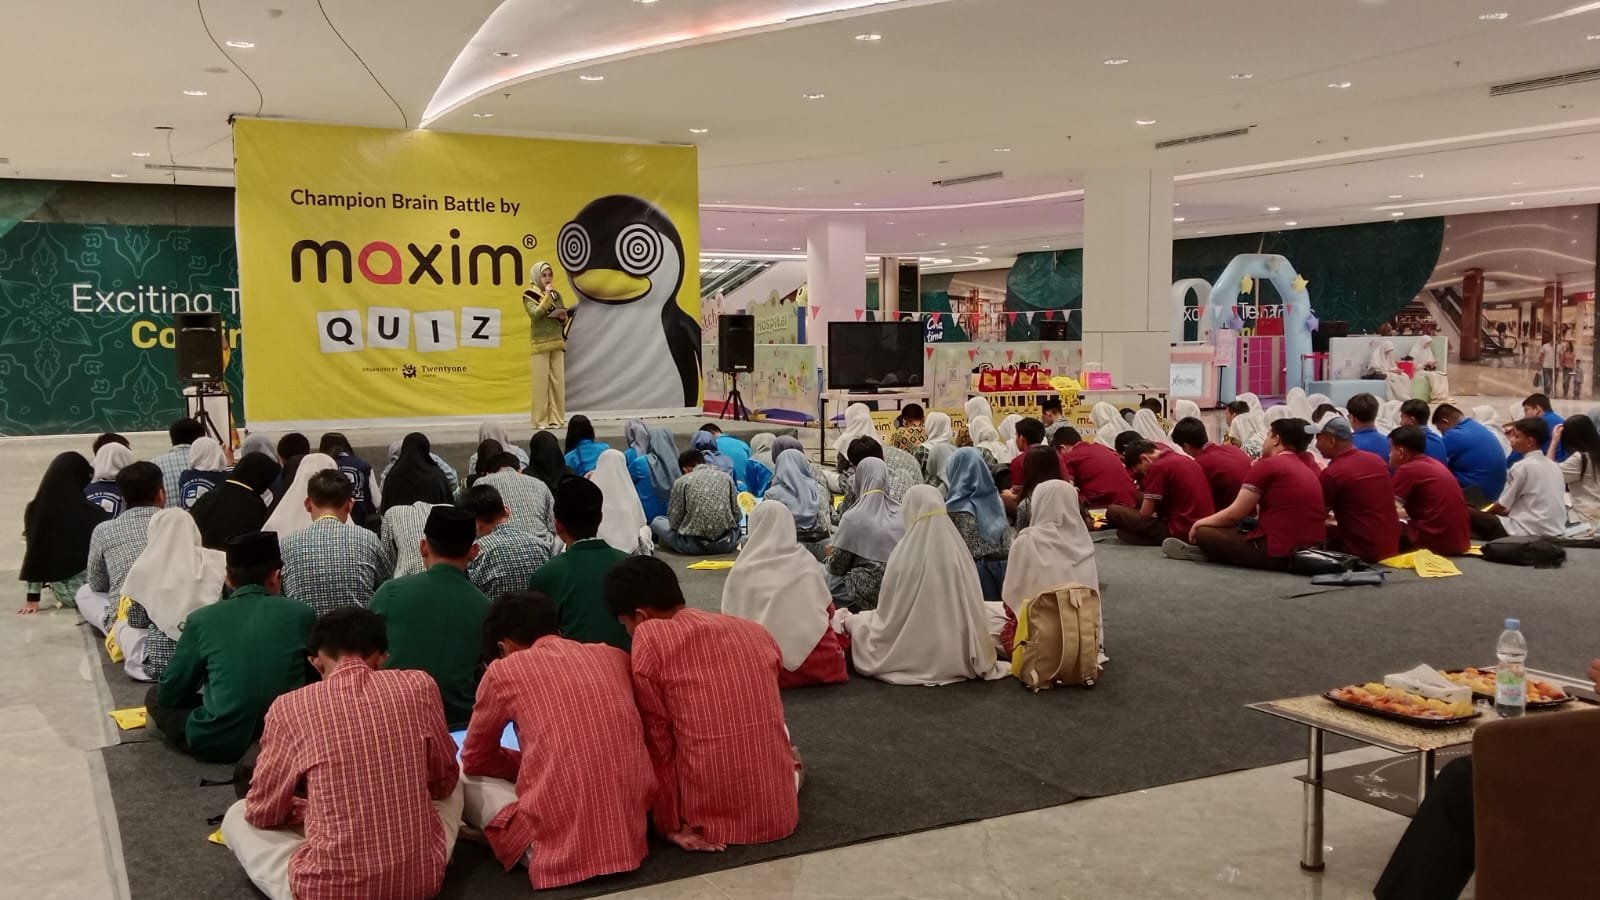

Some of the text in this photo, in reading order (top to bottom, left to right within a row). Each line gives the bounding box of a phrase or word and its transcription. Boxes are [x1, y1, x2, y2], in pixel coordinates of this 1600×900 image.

[290, 189, 521, 216] Champion Brain Battle by
[421, 365, 467, 374] Twentyone
